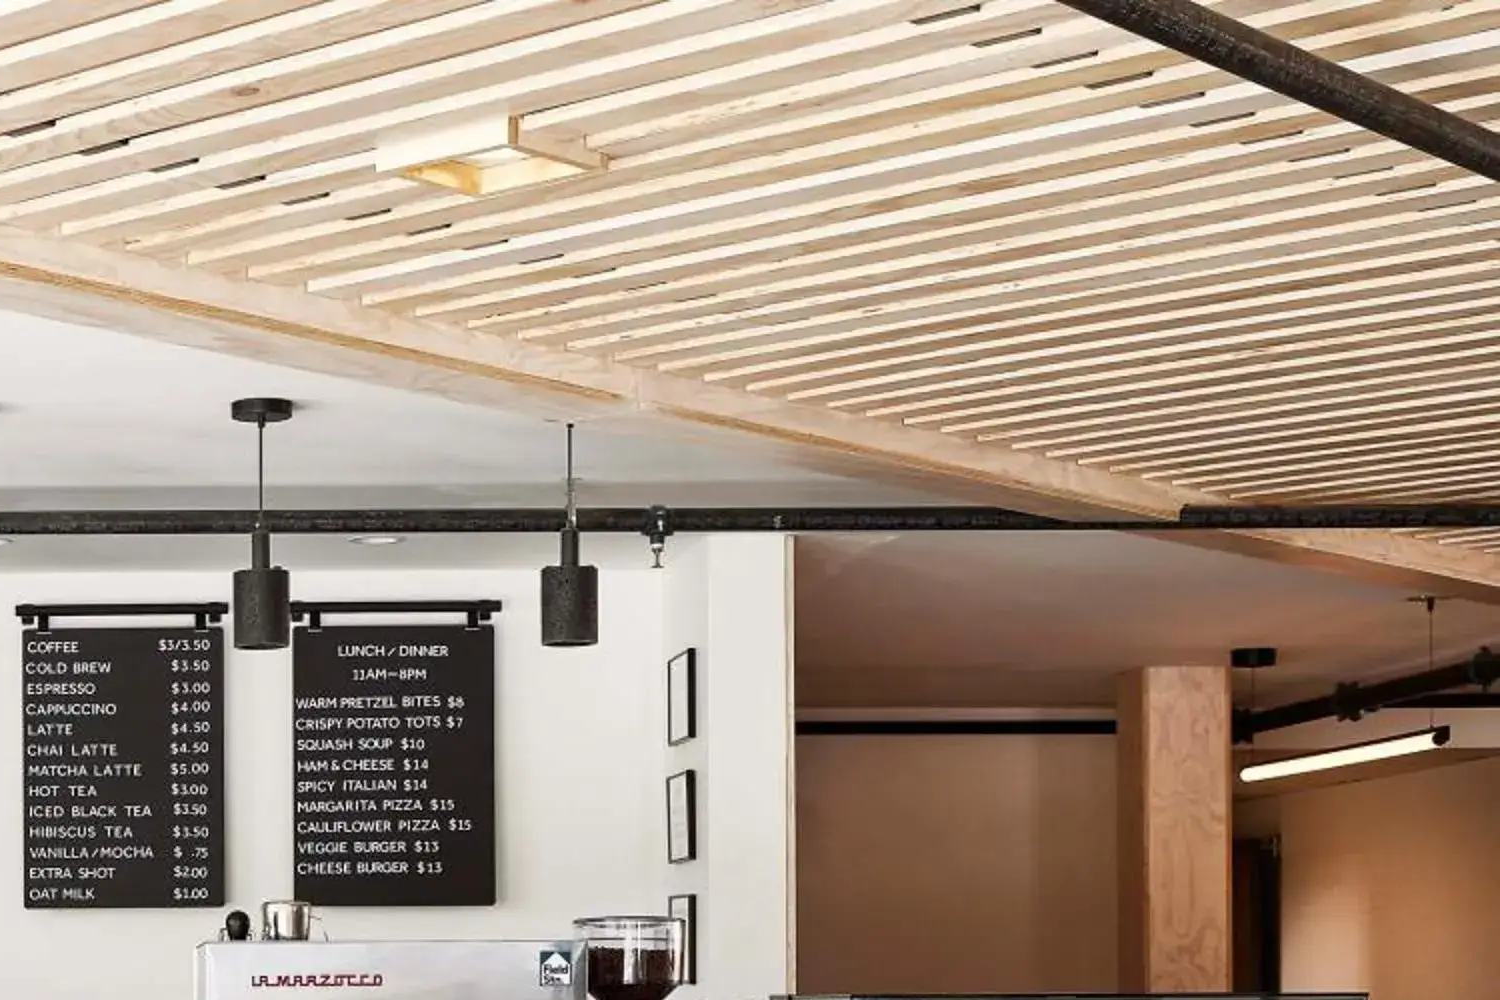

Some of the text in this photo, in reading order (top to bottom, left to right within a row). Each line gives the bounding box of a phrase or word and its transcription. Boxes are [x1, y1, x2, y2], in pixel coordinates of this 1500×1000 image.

[27, 639, 210, 653] COFFEE $3/3.50
[26, 660, 210, 674] COLD BREW $3.50
[27, 682, 210, 695] ESPRESSO $3.00
[26, 701, 210, 715] CAPPUCCINO $4.00
[296, 698, 337, 709] WARM
[340, 696, 397, 708] PRETZEL
[402, 696, 440, 707] BITES
[28, 722, 210, 735] LATTE $4.50
[296, 716, 463, 730] CRISPY POTATO TOTS $7
[28, 742, 208, 756] CHAI LATTE $4.50
[298, 738, 424, 750] SQUASH SOUP $10
[29, 763, 209, 776] MATCHA LATTE $5.00
[298, 759, 428, 772] HAM & CHEESE $14
[29, 783, 208, 796] HOT TEA $3.00
[298, 779, 427, 792] SPICY ITALIAN $14
[30, 803, 207, 818] ICED BLACK TEA $3.50
[298, 800, 376, 812] MARGARITA
[383, 800, 422, 810] PIZZA
[30, 826, 208, 838] HIBISCUS TEA $3.50
[297, 818, 471, 833] CAULIFLOWER PIZZA $15
[298, 841, 439, 854] VEGGIE BURGER $13
[30, 866, 207, 878] EXTRA SHOT $2.00
[298, 862, 442, 874] CHEESE BURGER $13
[30, 888, 208, 900] OAT MILK $1.00
